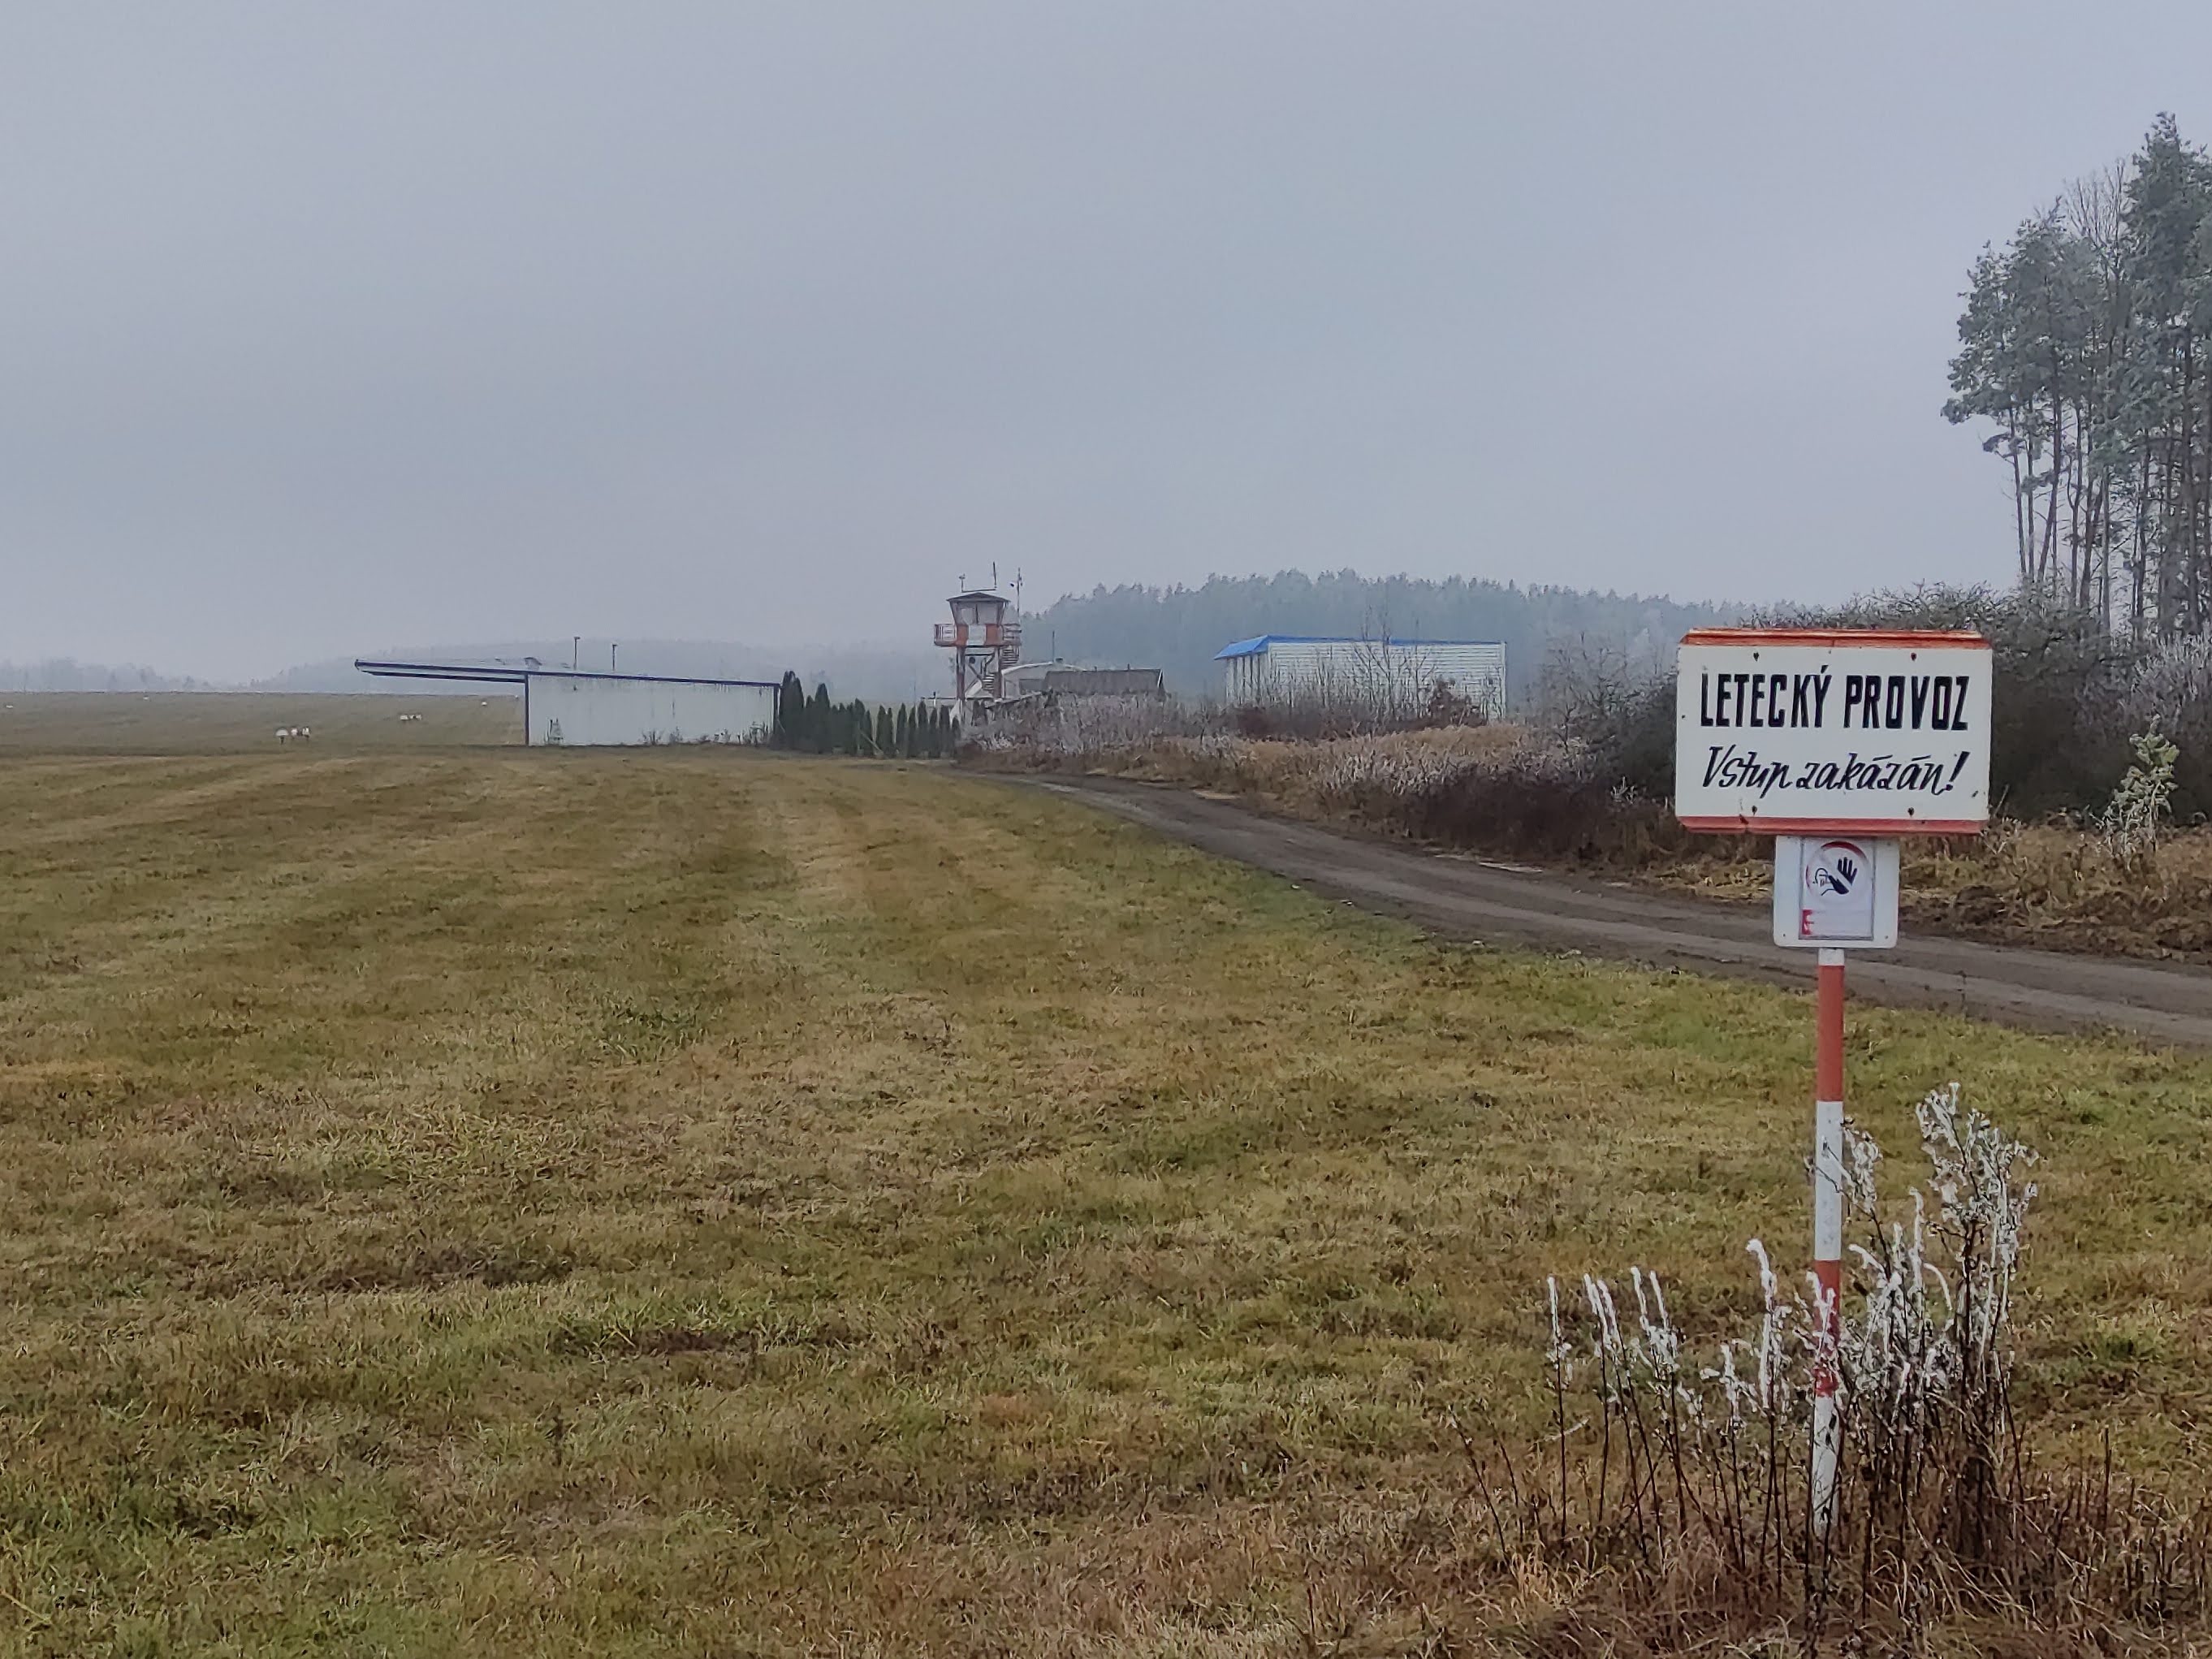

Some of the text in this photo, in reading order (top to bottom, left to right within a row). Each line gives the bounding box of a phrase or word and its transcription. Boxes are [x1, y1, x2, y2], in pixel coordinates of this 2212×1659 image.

[1700, 664, 1969, 731] LETECKÝ PROVOZ
[1702, 744, 1971, 799] Vstup zakázán!
